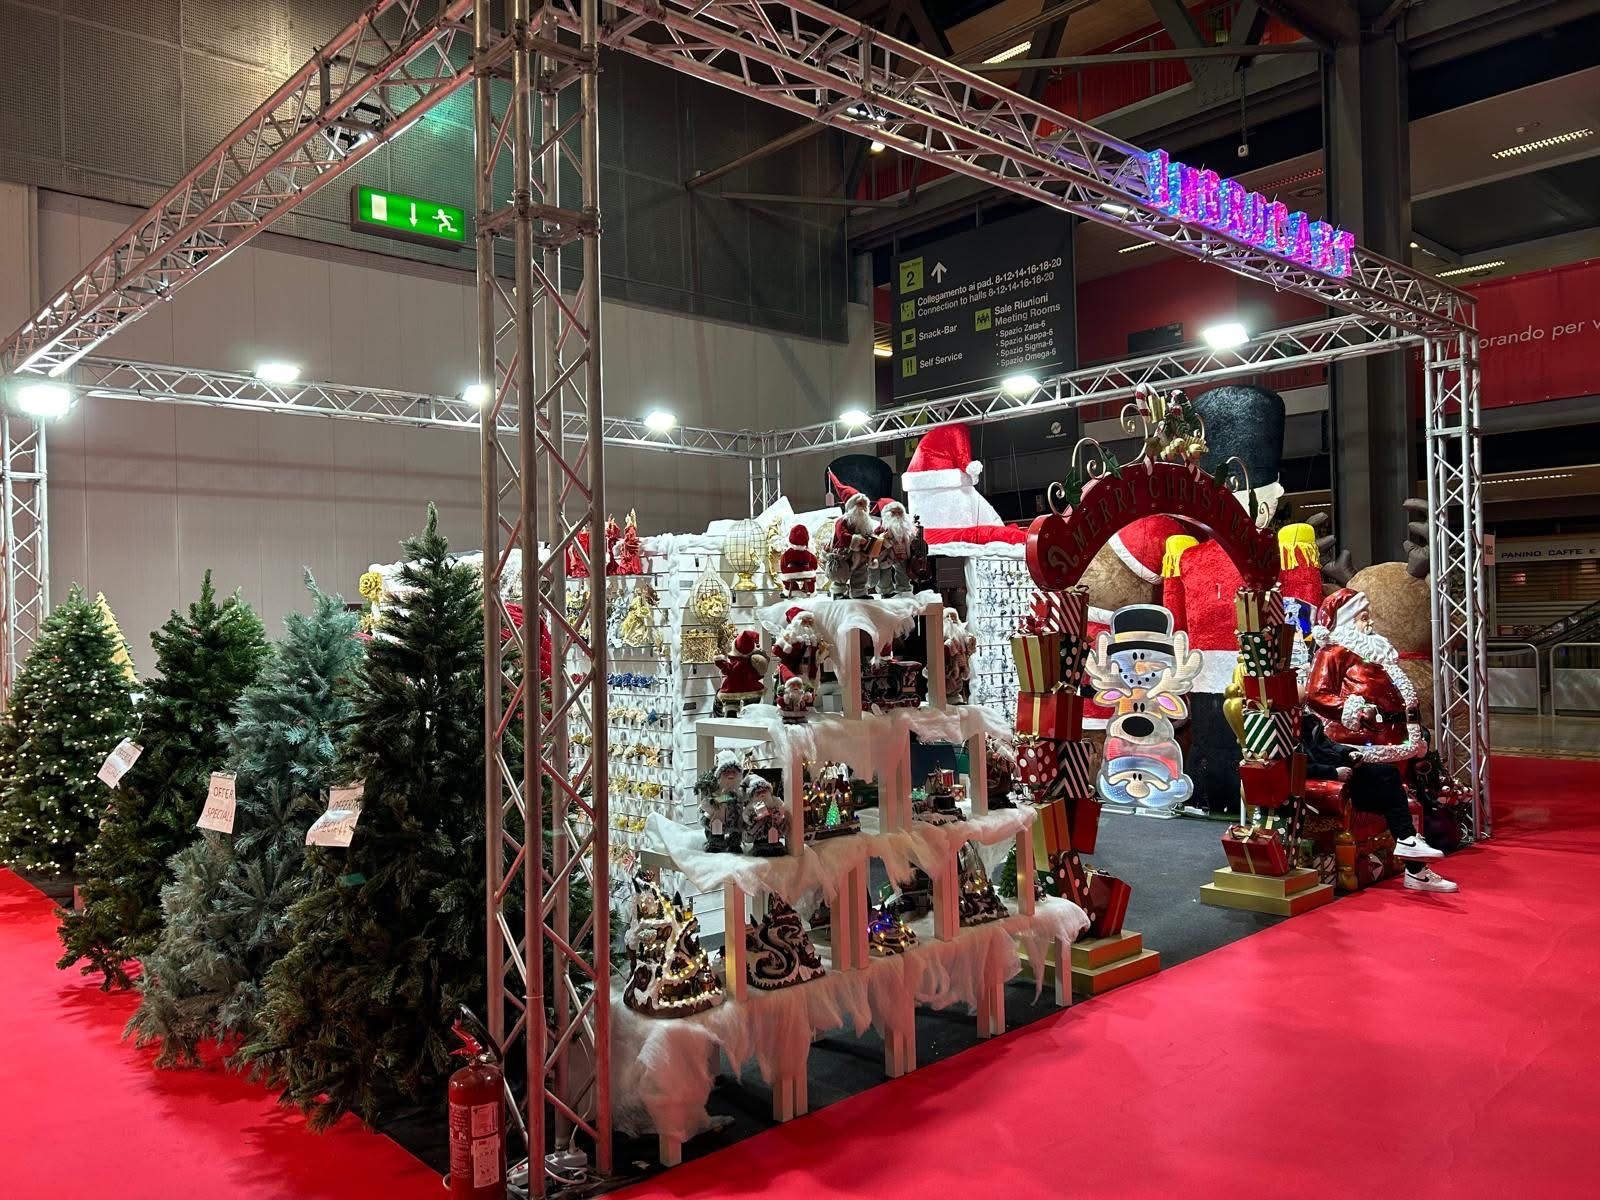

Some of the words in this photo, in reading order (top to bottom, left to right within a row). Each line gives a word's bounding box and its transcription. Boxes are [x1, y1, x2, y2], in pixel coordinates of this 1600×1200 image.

[906, 271, 916, 287] 2
[917, 286, 967, 307] Collegamento
[968, 281, 976, 292] ai
[976, 277, 994, 292] pad.
[917, 299, 959, 317] Connection
[960, 296, 968, 307] to
[969, 290, 987, 304] halls
[994, 303, 1012, 315] Sale
[1014, 293, 1049, 311] Riunioni
[994, 310, 1028, 327] Meeting
[1029, 303, 1061, 319] Rooms
[919, 324, 958, 341] Snack-Bar
[1000, 327, 1023, 338] Spazio
[1023, 320, 1046, 332] Zeta-6
[1000, 337, 1023, 348] Spazio
[1024, 328, 1053, 343] Kappa-6
[1551, 321, 1585, 341] per
[1000, 347, 1023, 358] Spazio
[1024, 338, 1053, 353] Sigma-6
[1000, 356, 1023, 367] Spazio
[1025, 347, 1057, 363] Omega-6
[920, 357, 934, 369] Self
[935, 352, 963, 366] Service
[1072, 480, 1138, 553] MERRY
[1501, 550, 1542, 559] PANINO
